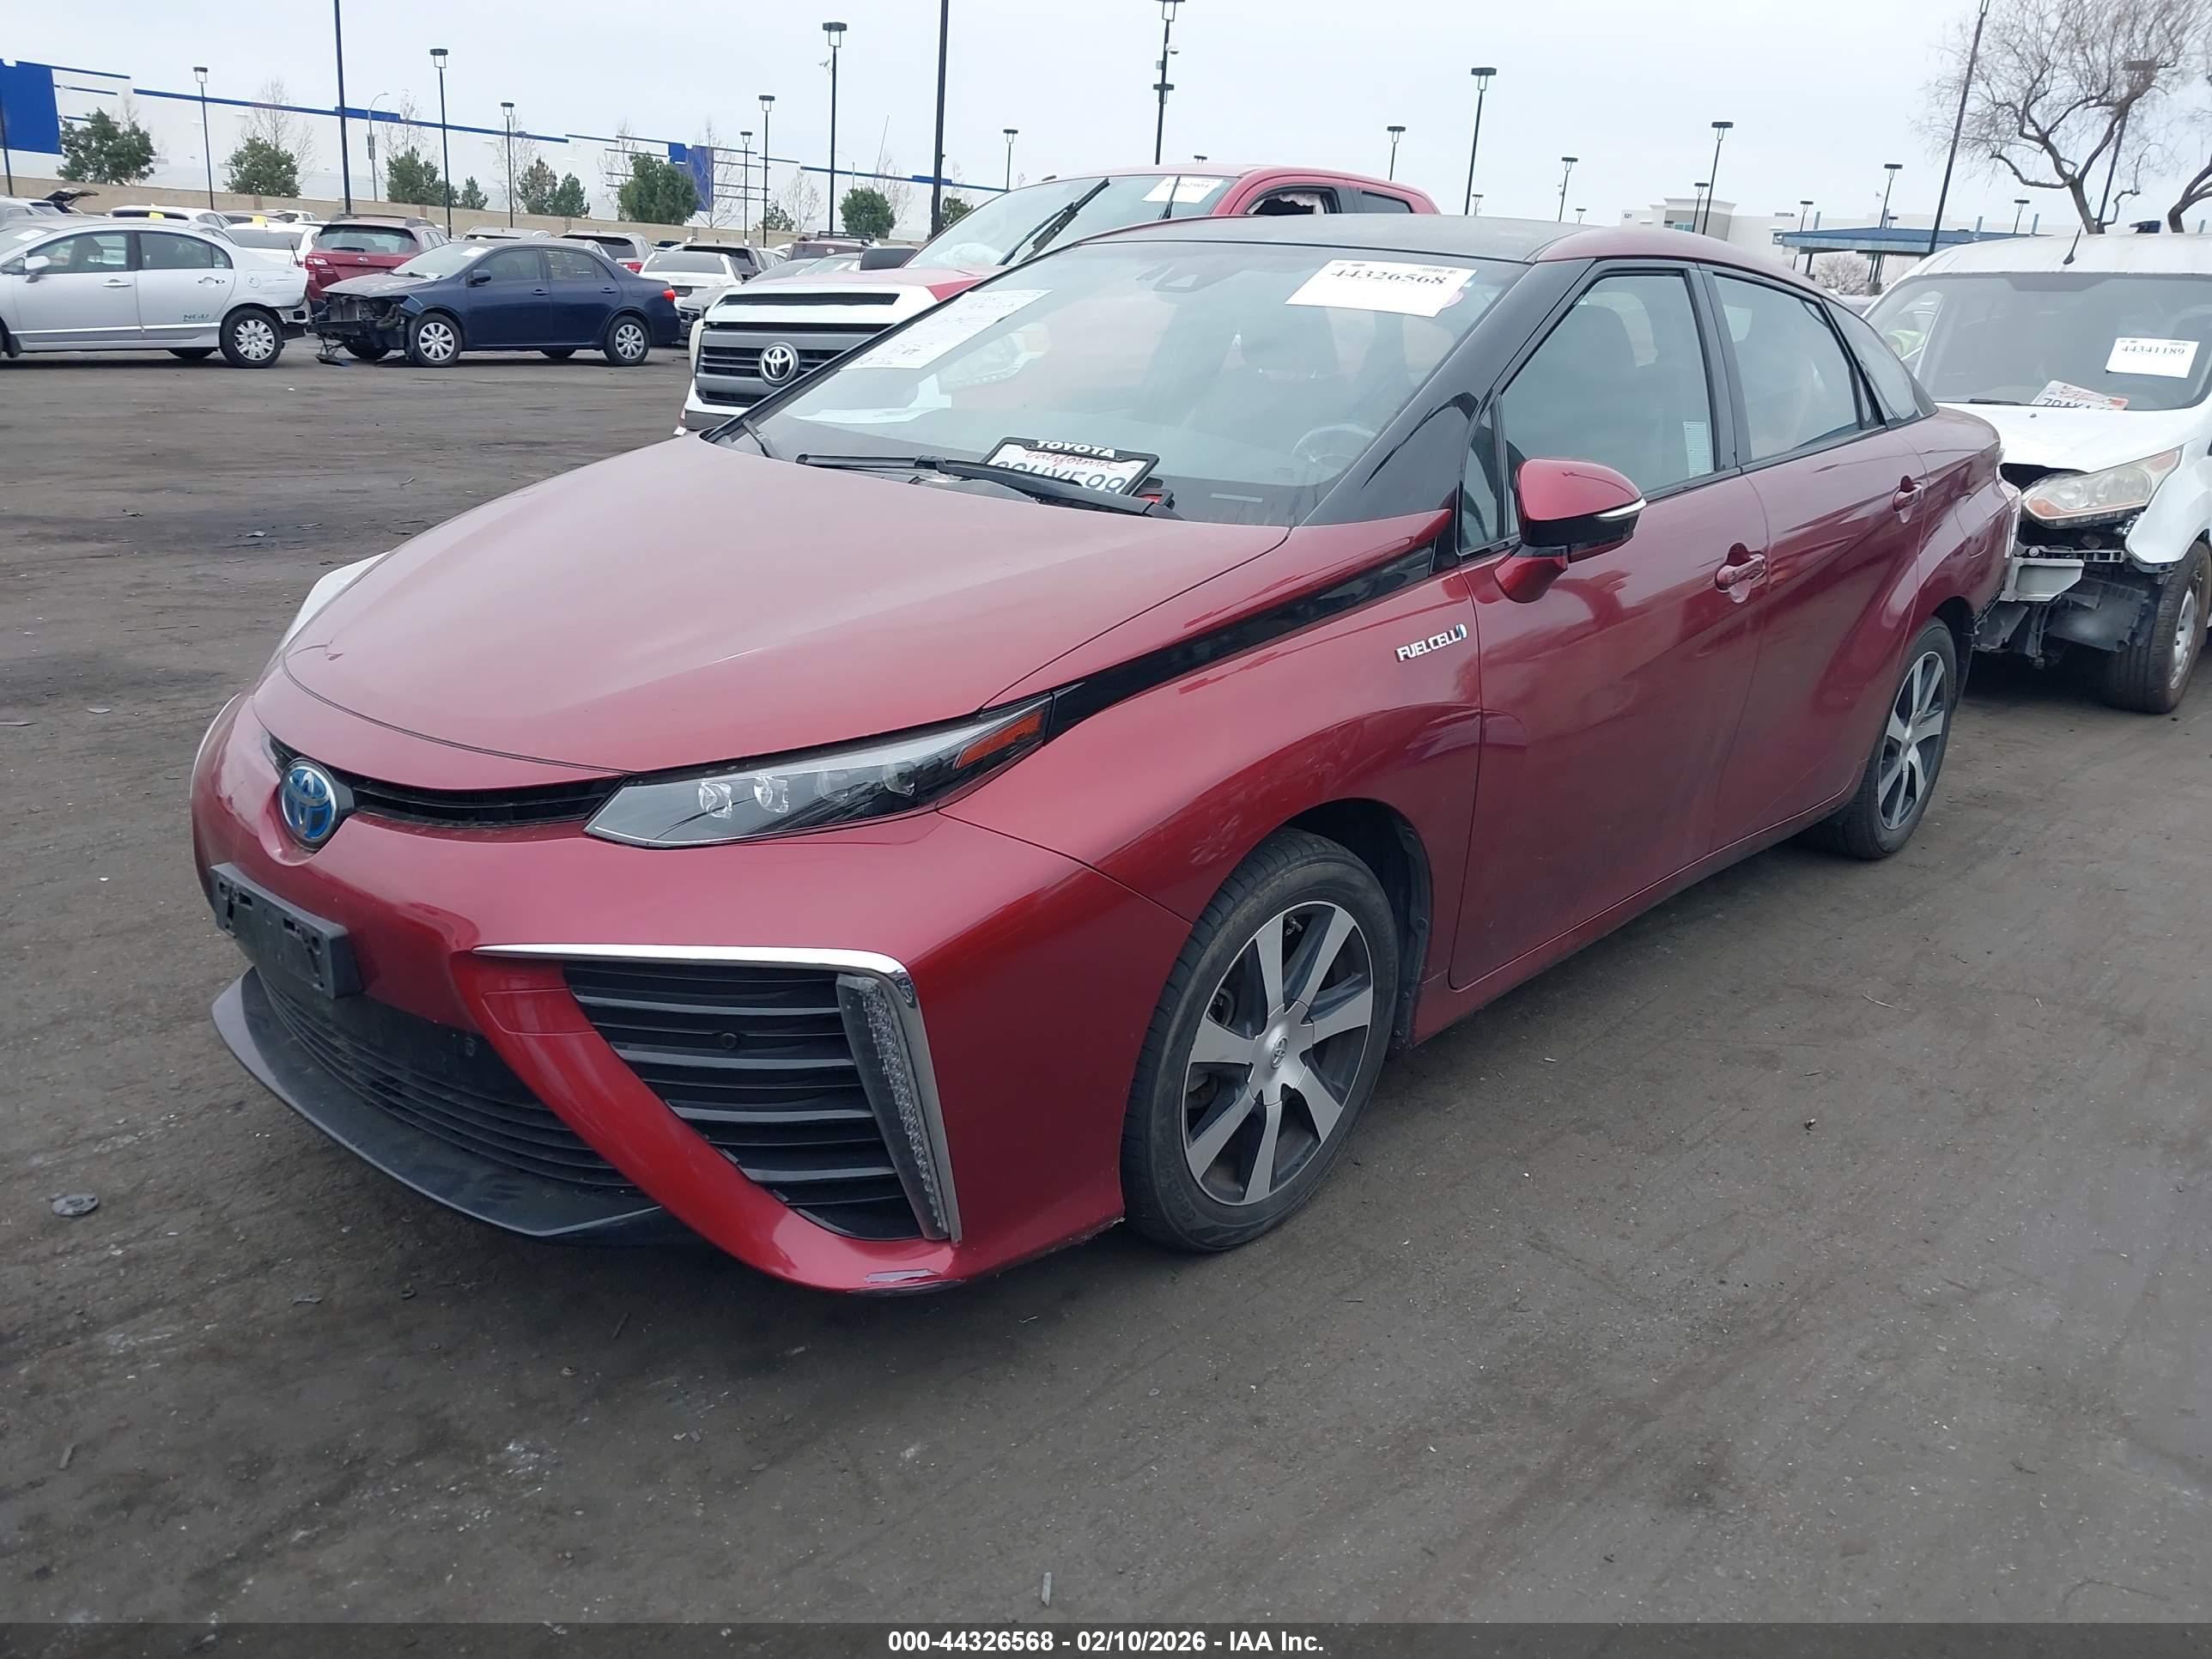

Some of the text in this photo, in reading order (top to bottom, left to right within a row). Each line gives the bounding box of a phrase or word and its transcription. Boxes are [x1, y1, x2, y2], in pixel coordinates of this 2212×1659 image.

[1330, 269, 1447, 285] 44326568
[2121, 345, 2185, 356] 44341189
[1036, 440, 1115, 459] TOYOTA
[1025, 451, 1117, 470] California
